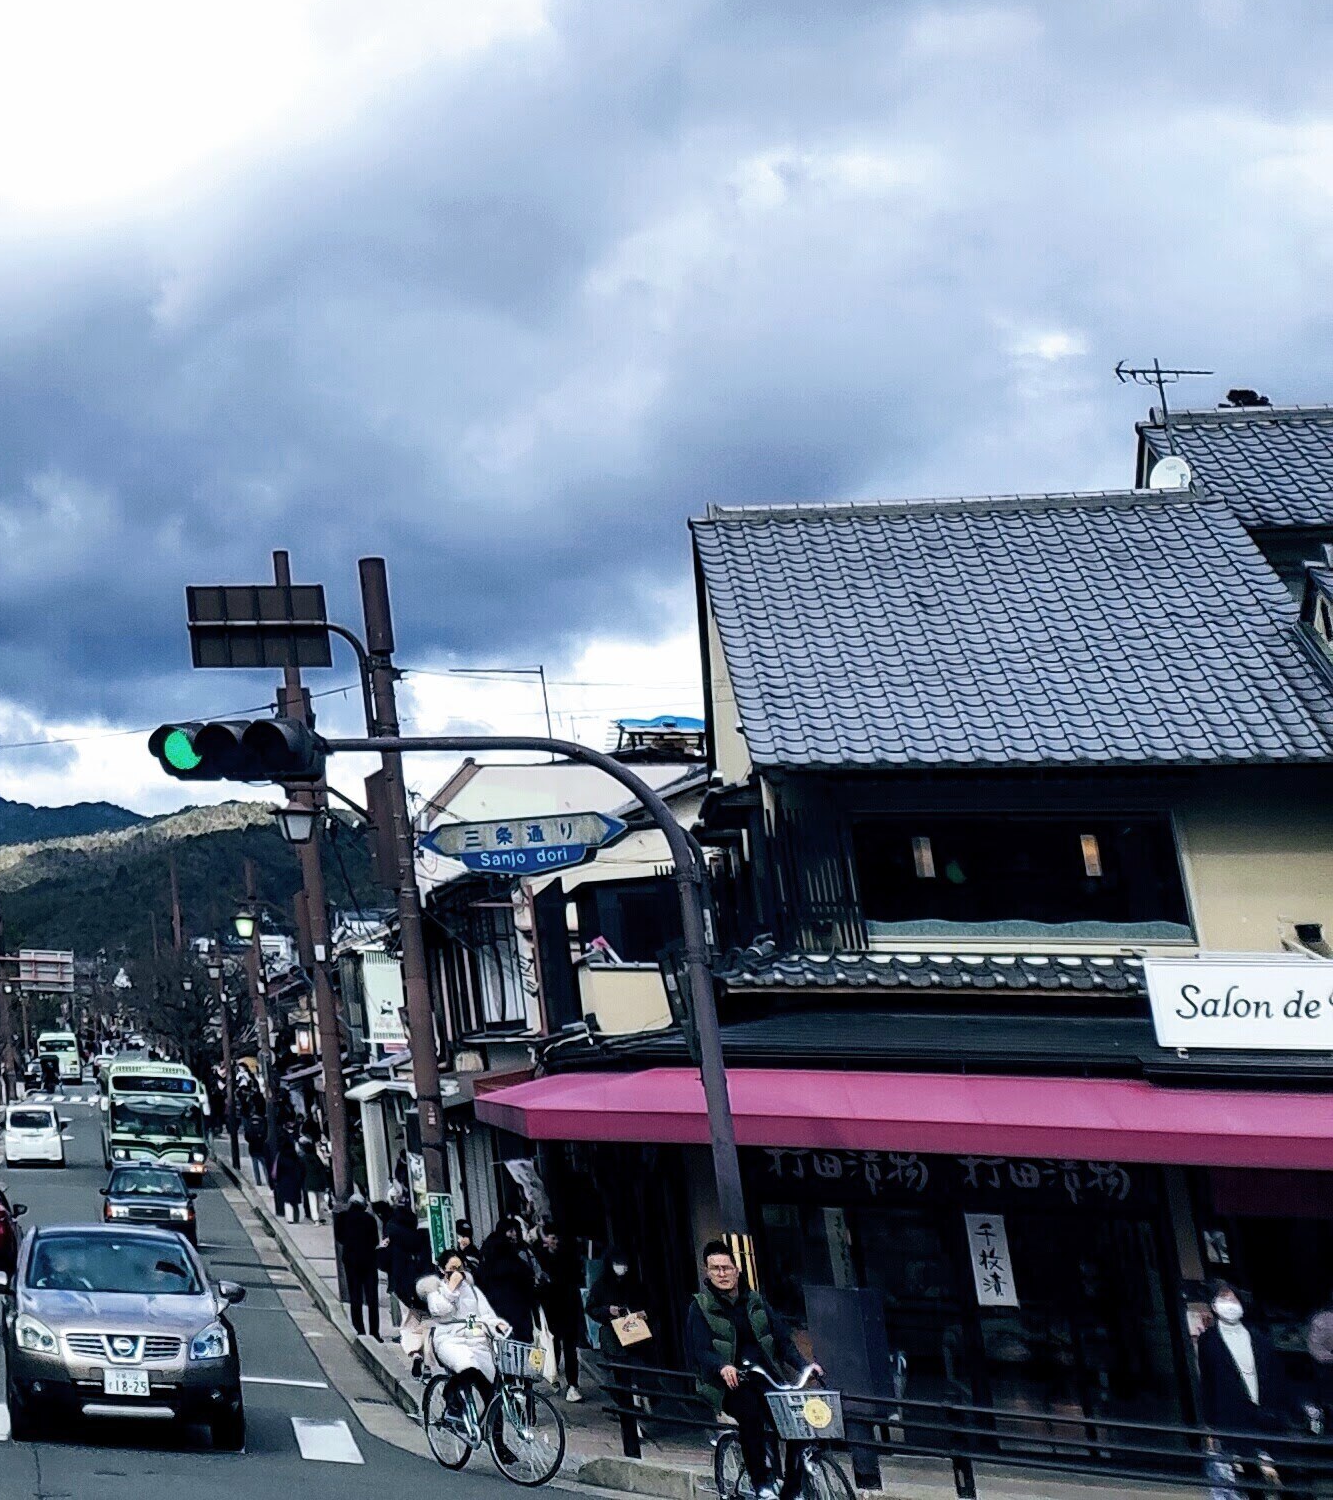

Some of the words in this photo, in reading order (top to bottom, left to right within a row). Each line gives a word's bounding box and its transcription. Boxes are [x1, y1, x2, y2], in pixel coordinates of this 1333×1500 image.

[464, 822, 573, 848] 三条通り
[480, 851, 526, 868] Sanjo
[536, 846, 568, 863] dori
[1175, 984, 1274, 1019] Salon
[1283, 989, 1321, 1019] de
[973, 1221, 1007, 1298] 千枚漬
[115, 1379, 148, 1393] 18-25
